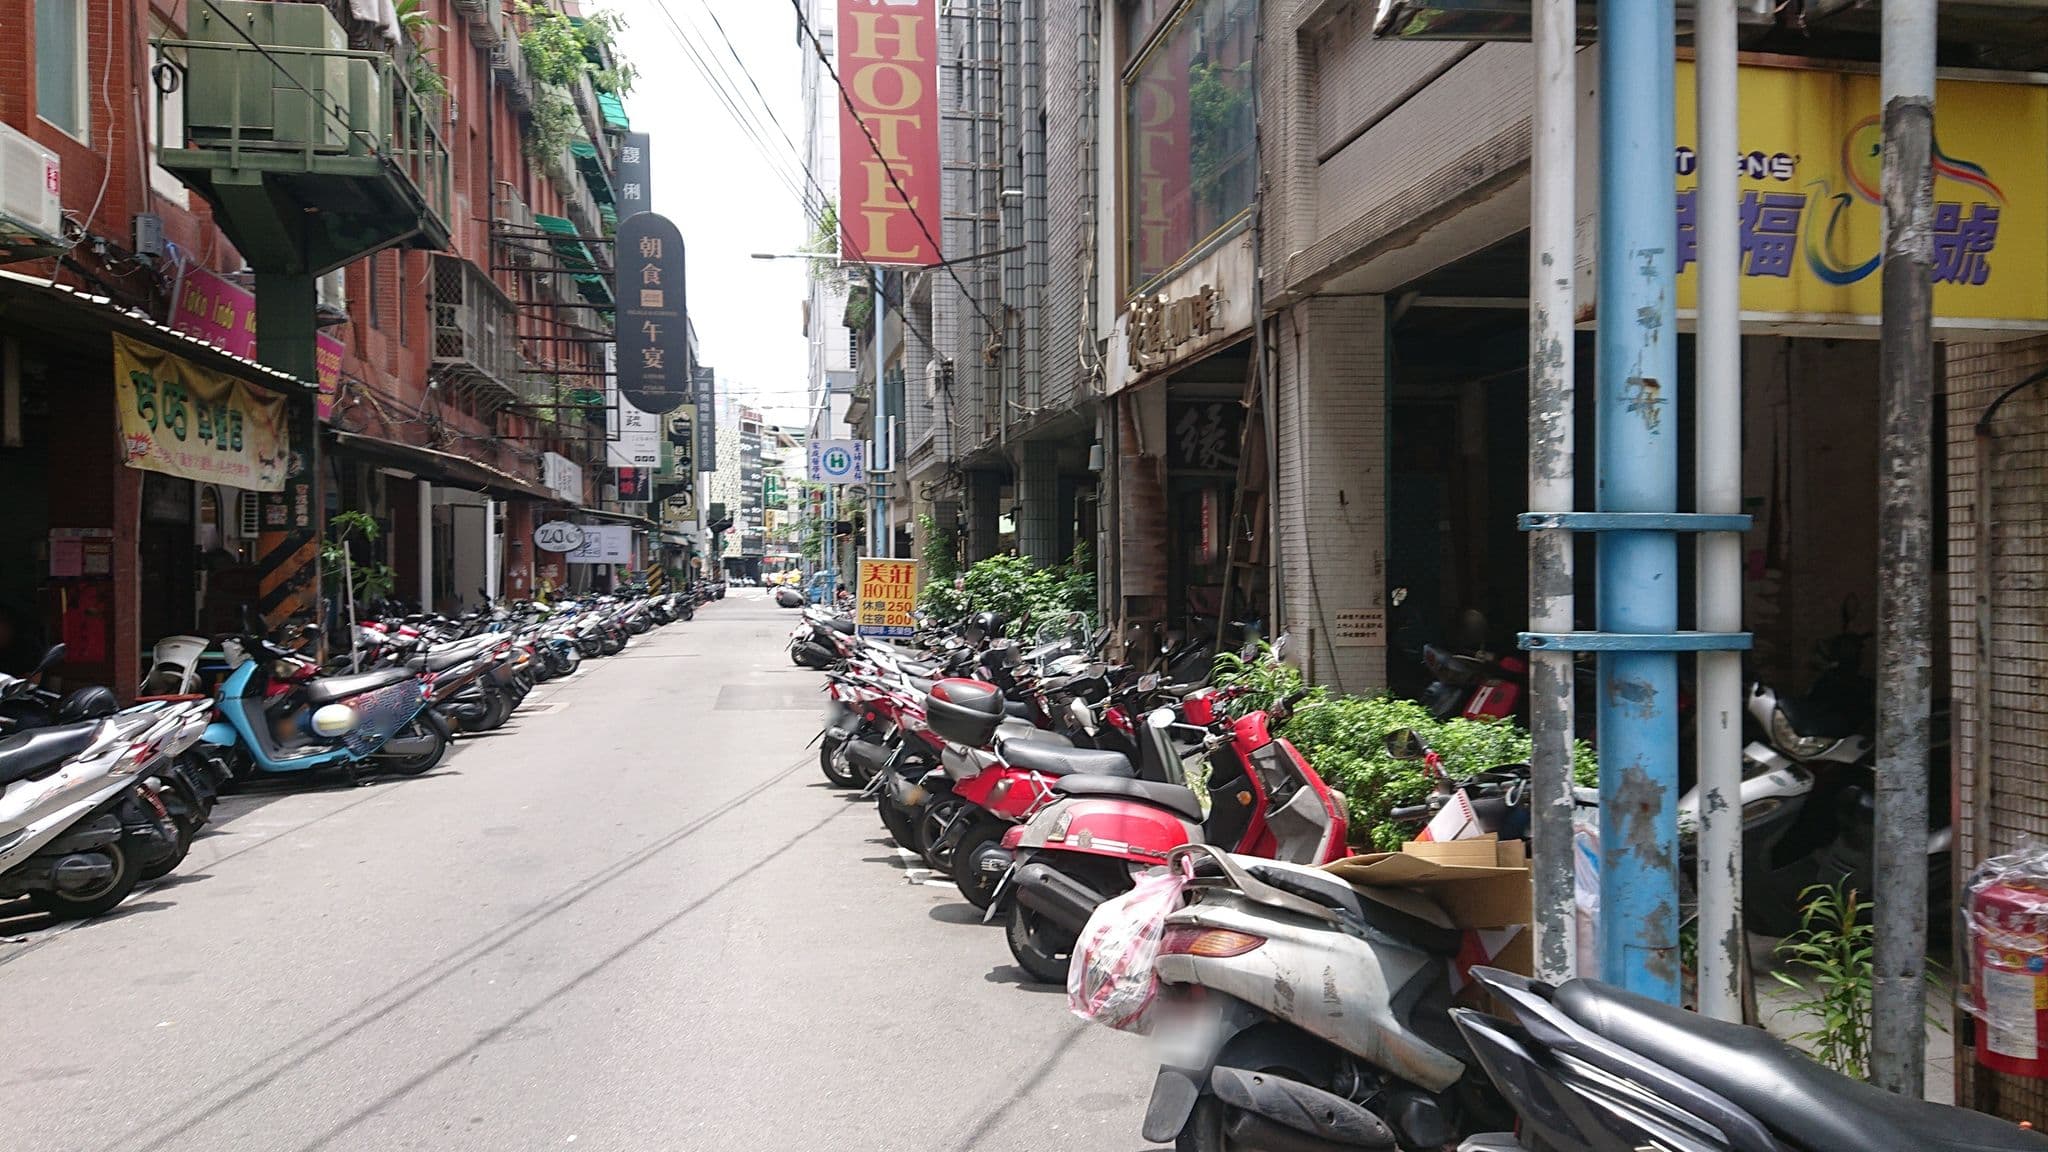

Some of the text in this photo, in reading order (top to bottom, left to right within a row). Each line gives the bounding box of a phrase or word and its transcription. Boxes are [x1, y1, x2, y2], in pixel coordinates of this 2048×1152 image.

[849, 11, 925, 259] HOTEL
[640, 236, 663, 285] 朝食
[641, 320, 665, 369] 午宴
[862, 600, 912, 612] 休息 250
[863, 583, 914, 599] HOTEL
[862, 613, 912, 625] 住宿 800
